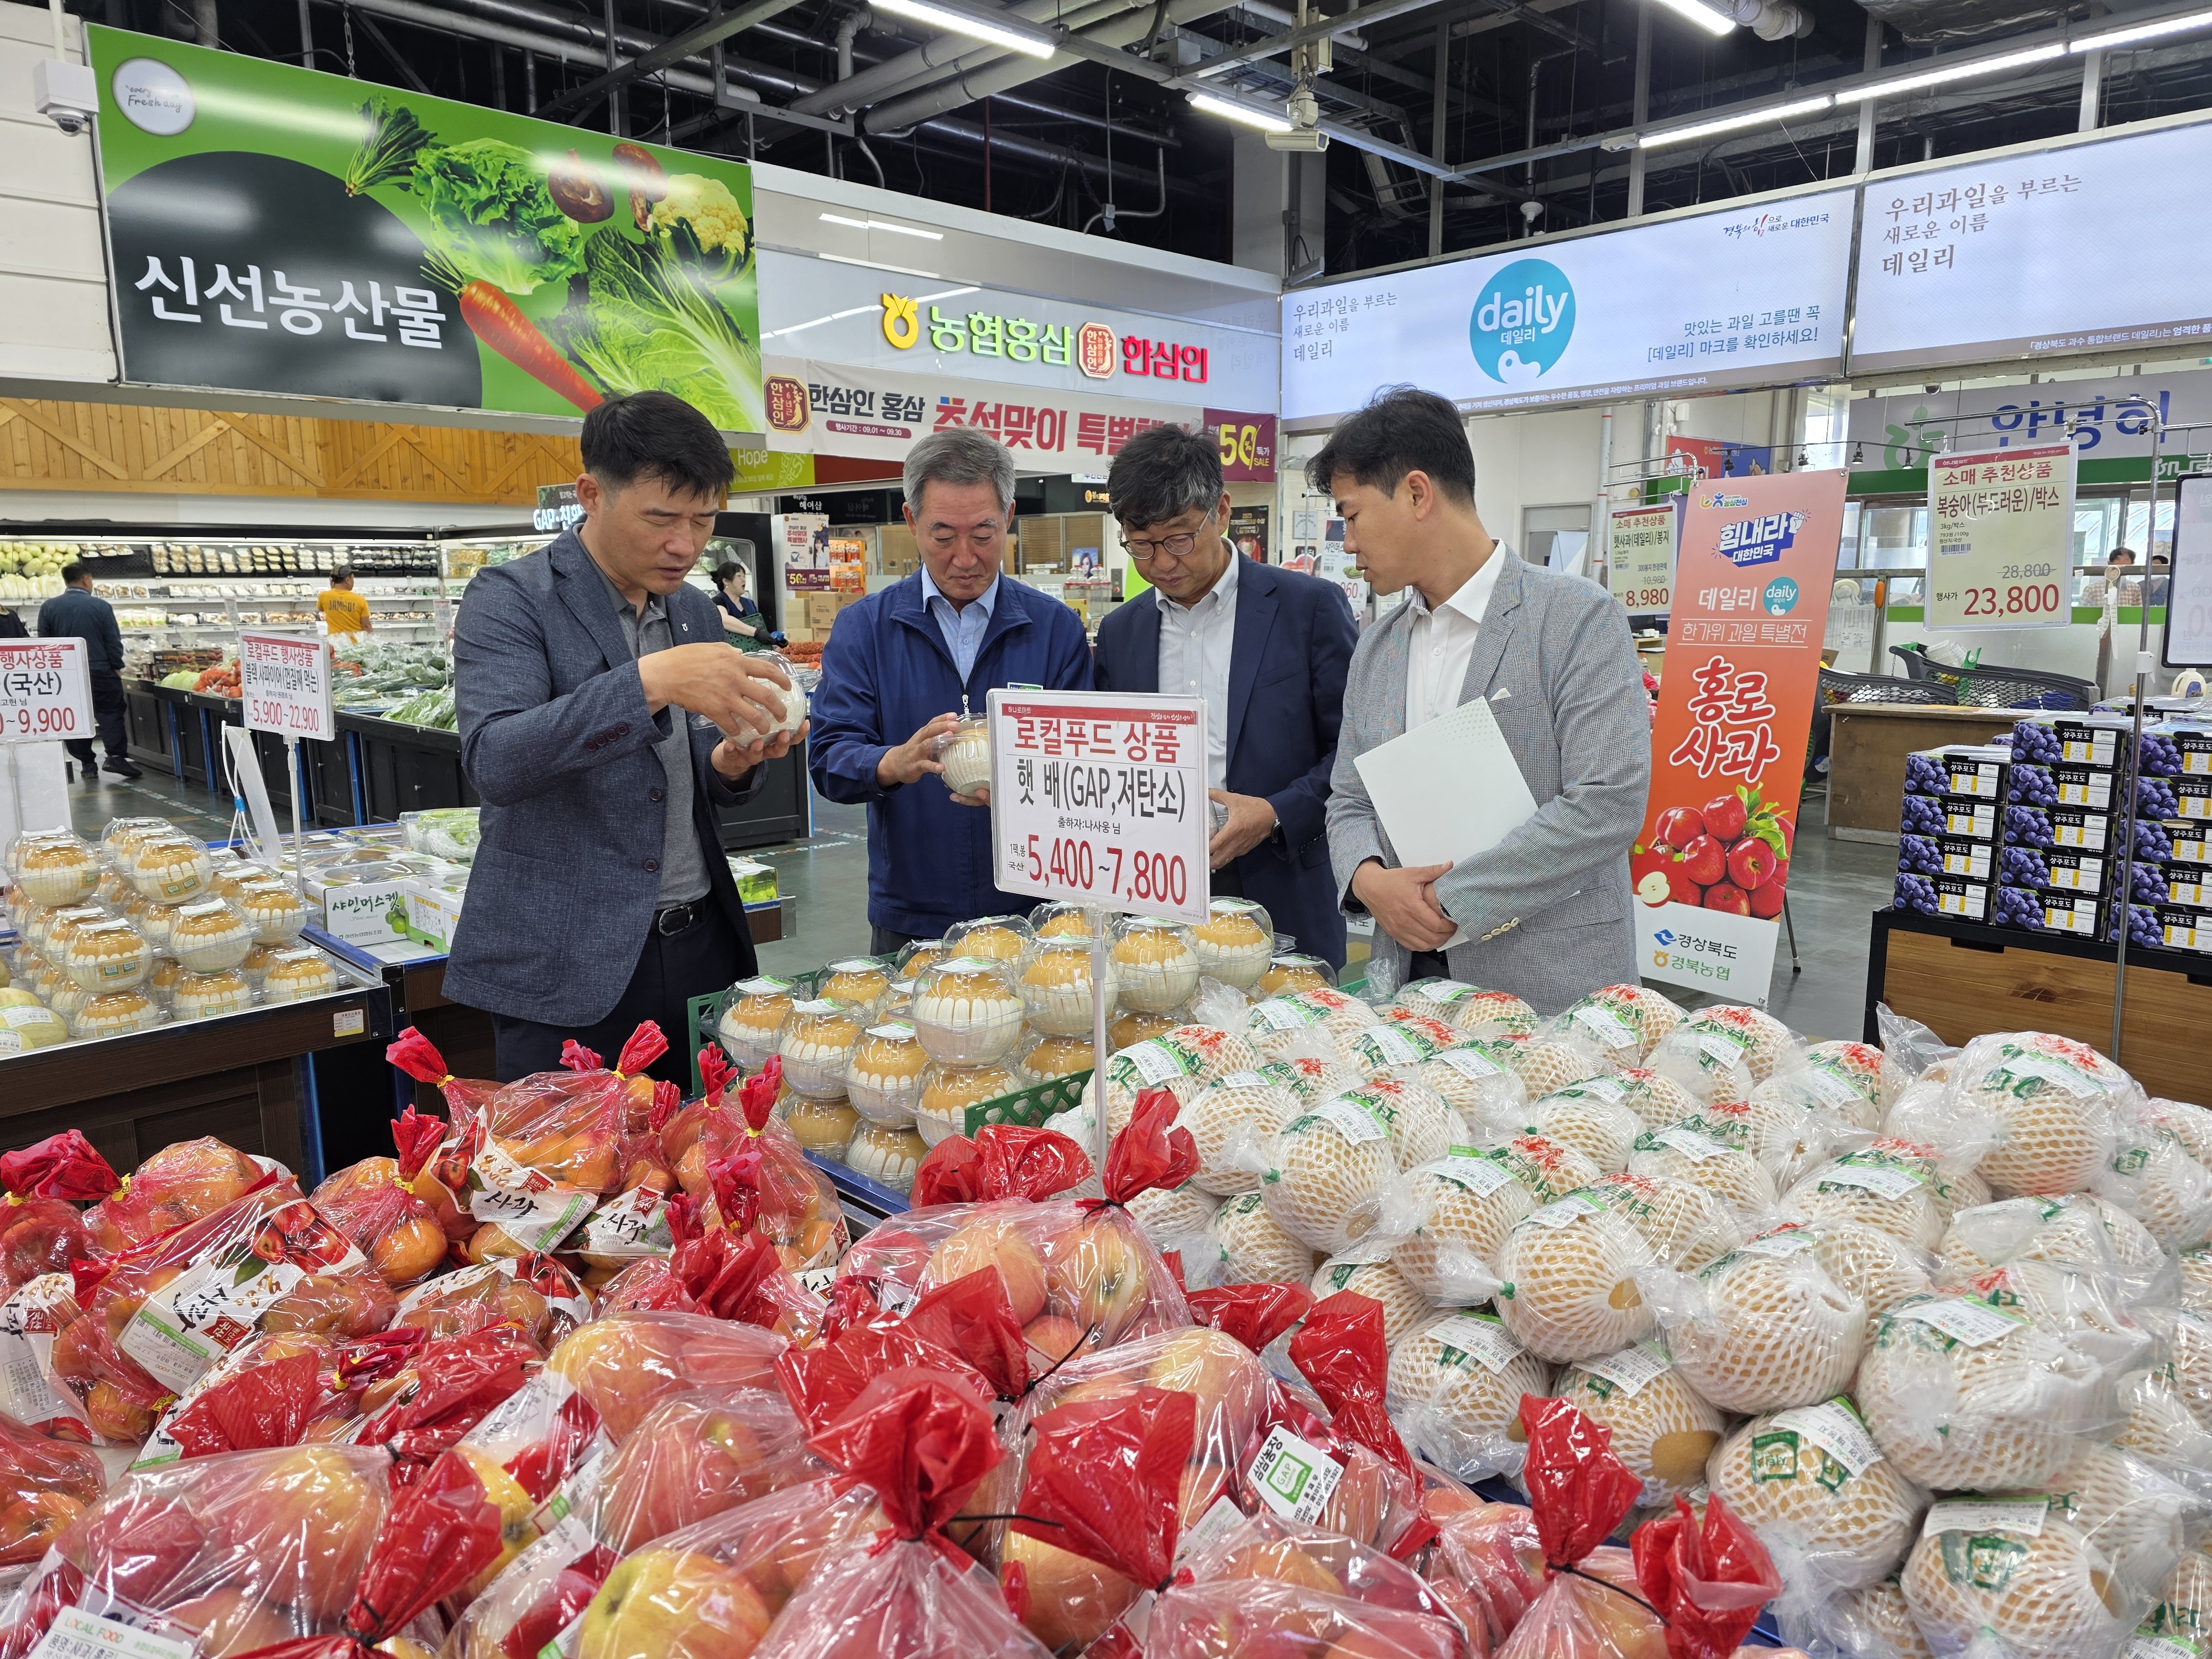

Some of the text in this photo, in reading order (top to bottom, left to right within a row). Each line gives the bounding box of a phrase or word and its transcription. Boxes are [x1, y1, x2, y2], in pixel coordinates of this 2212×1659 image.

[128, 95, 161, 107] Fresh
[1886, 174, 2083, 222] 우리과일을 부르는
[1790, 213, 1830, 229] 대한민국
[1882, 212, 1990, 245] 새로운 이름
[1881, 244, 1955, 276] 데일리
[134, 255, 446, 349] 신선농산물
[1293, 292, 1398, 324] 우리과일을 부르는
[1477, 284, 1569, 334] daily
[1293, 317, 1350, 339] 새로운 이름
[1684, 305, 1821, 337] 맛있는 과일 고를땐 꼭
[930, 305, 1074, 366] 농협홍삼
[1500, 327, 1536, 346] 데일리
[1648, 326, 1819, 363] [데일리] 마크를 확인하세요!
[2068, 337, 2085, 347] 과수
[2086, 332, 2130, 346] 통합브랜드
[2173, 324, 2201, 337] 엄격한
[1086, 330, 1097, 370] 한삼인
[1122, 335, 1208, 383] 한삼인
[1293, 340, 1333, 362] 데일리
[1634, 382, 1657, 392] 프리미엄
[1657, 380, 1670, 389] 과일
[1670, 377, 1708, 388] 브랜드입니다.
[770, 382, 784, 425] 한삼인
[808, 383, 875, 418] 한삼인
[881, 392, 926, 423] 홍삼
[835, 423, 857, 432] 행사기간
[862, 425, 878, 434] 09.01
[886, 427, 902, 437] 09.30
[737, 448, 768, 468] Hope
[1256, 446, 1270, 456] 특가
[1253, 457, 1270, 466] SALE
[1943, 461, 2053, 486] 소매 추천상품
[799, 500, 822, 510] 헤이샵
[1724, 498, 1747, 507] 농심천심
[1937, 486, 2059, 519] 복숭아(부드러운)/박스
[1615, 515, 1666, 529] 소매 추천상품
[1719, 512, 1790, 549] 힘내라
[1940, 521, 1965, 530] 3kg/박스
[1614, 529, 1670, 549] 햇사과(데일리)/봉지
[1732, 544, 1774, 564] 대한민국
[1643, 575, 1666, 585] 10,980
[2001, 563, 2051, 579] 28,800
[1626, 588, 1669, 608] 8,980
[1699, 584, 1797, 612] 데일리 daily
[1936, 583, 2060, 618] 행사가 23,800
[1682, 622, 1807, 643] 한가위 과일 특별전
[0, 651, 64, 670] 행사상품
[247, 642, 314, 668] 로컬푸드 행사상품
[3, 671, 62, 697] (국산)
[246, 661, 258, 686] 블랙
[304, 669, 319, 695] 먹는)
[1688, 655, 1776, 724] 홍로
[19, 698, 28, 706] 님
[1014, 718, 1181, 764] 로컬푸드 상품
[2062, 731, 2091, 740] 상주포도
[1669, 722, 1781, 783] 사과
[1950, 764, 1976, 773] 상주포도
[2058, 773, 2086, 782] 상주포도
[1017, 758, 1186, 823] 햇 배(GAP,저탄소)
[2178, 785, 2209, 795] 상주포도
[1946, 805, 1972, 814] 상주포도
[1057, 816, 1121, 836] 출하자:나사웅 님
[2053, 815, 2082, 825] 상주포도
[2172, 829, 2203, 839] 상주포도
[1943, 844, 1969, 854] 상주포도
[1008, 860, 1025, 872] 국산
[2049, 855, 2078, 867] 상주포도
[2168, 871, 2199, 882] 상주포도
[1938, 884, 1964, 893] 상주포도
[2044, 897, 2072, 909] 상주포도
[2162, 914, 2194, 925] 상주포도
[1679, 932, 1738, 959] 경상북도
[1671, 954, 1730, 982] 경북농협
[530, 1177, 546, 1191] 원산지
[484, 1190, 539, 1219] 사과
[602, 1213, 648, 1246] 사과
[213, 1319, 229, 1337] 국산
[223, 1327, 241, 1344] 원산지
[1463, 1343, 1498, 1367] LOCAL FOOD
[154, 1364, 188, 1380] LOCAL FOOD
[1599, 1366, 1634, 1389] LOCAL FOOD
[1276, 1463, 1292, 1485] GAP
[64, 1616, 124, 1644] LOCAL FOOD
